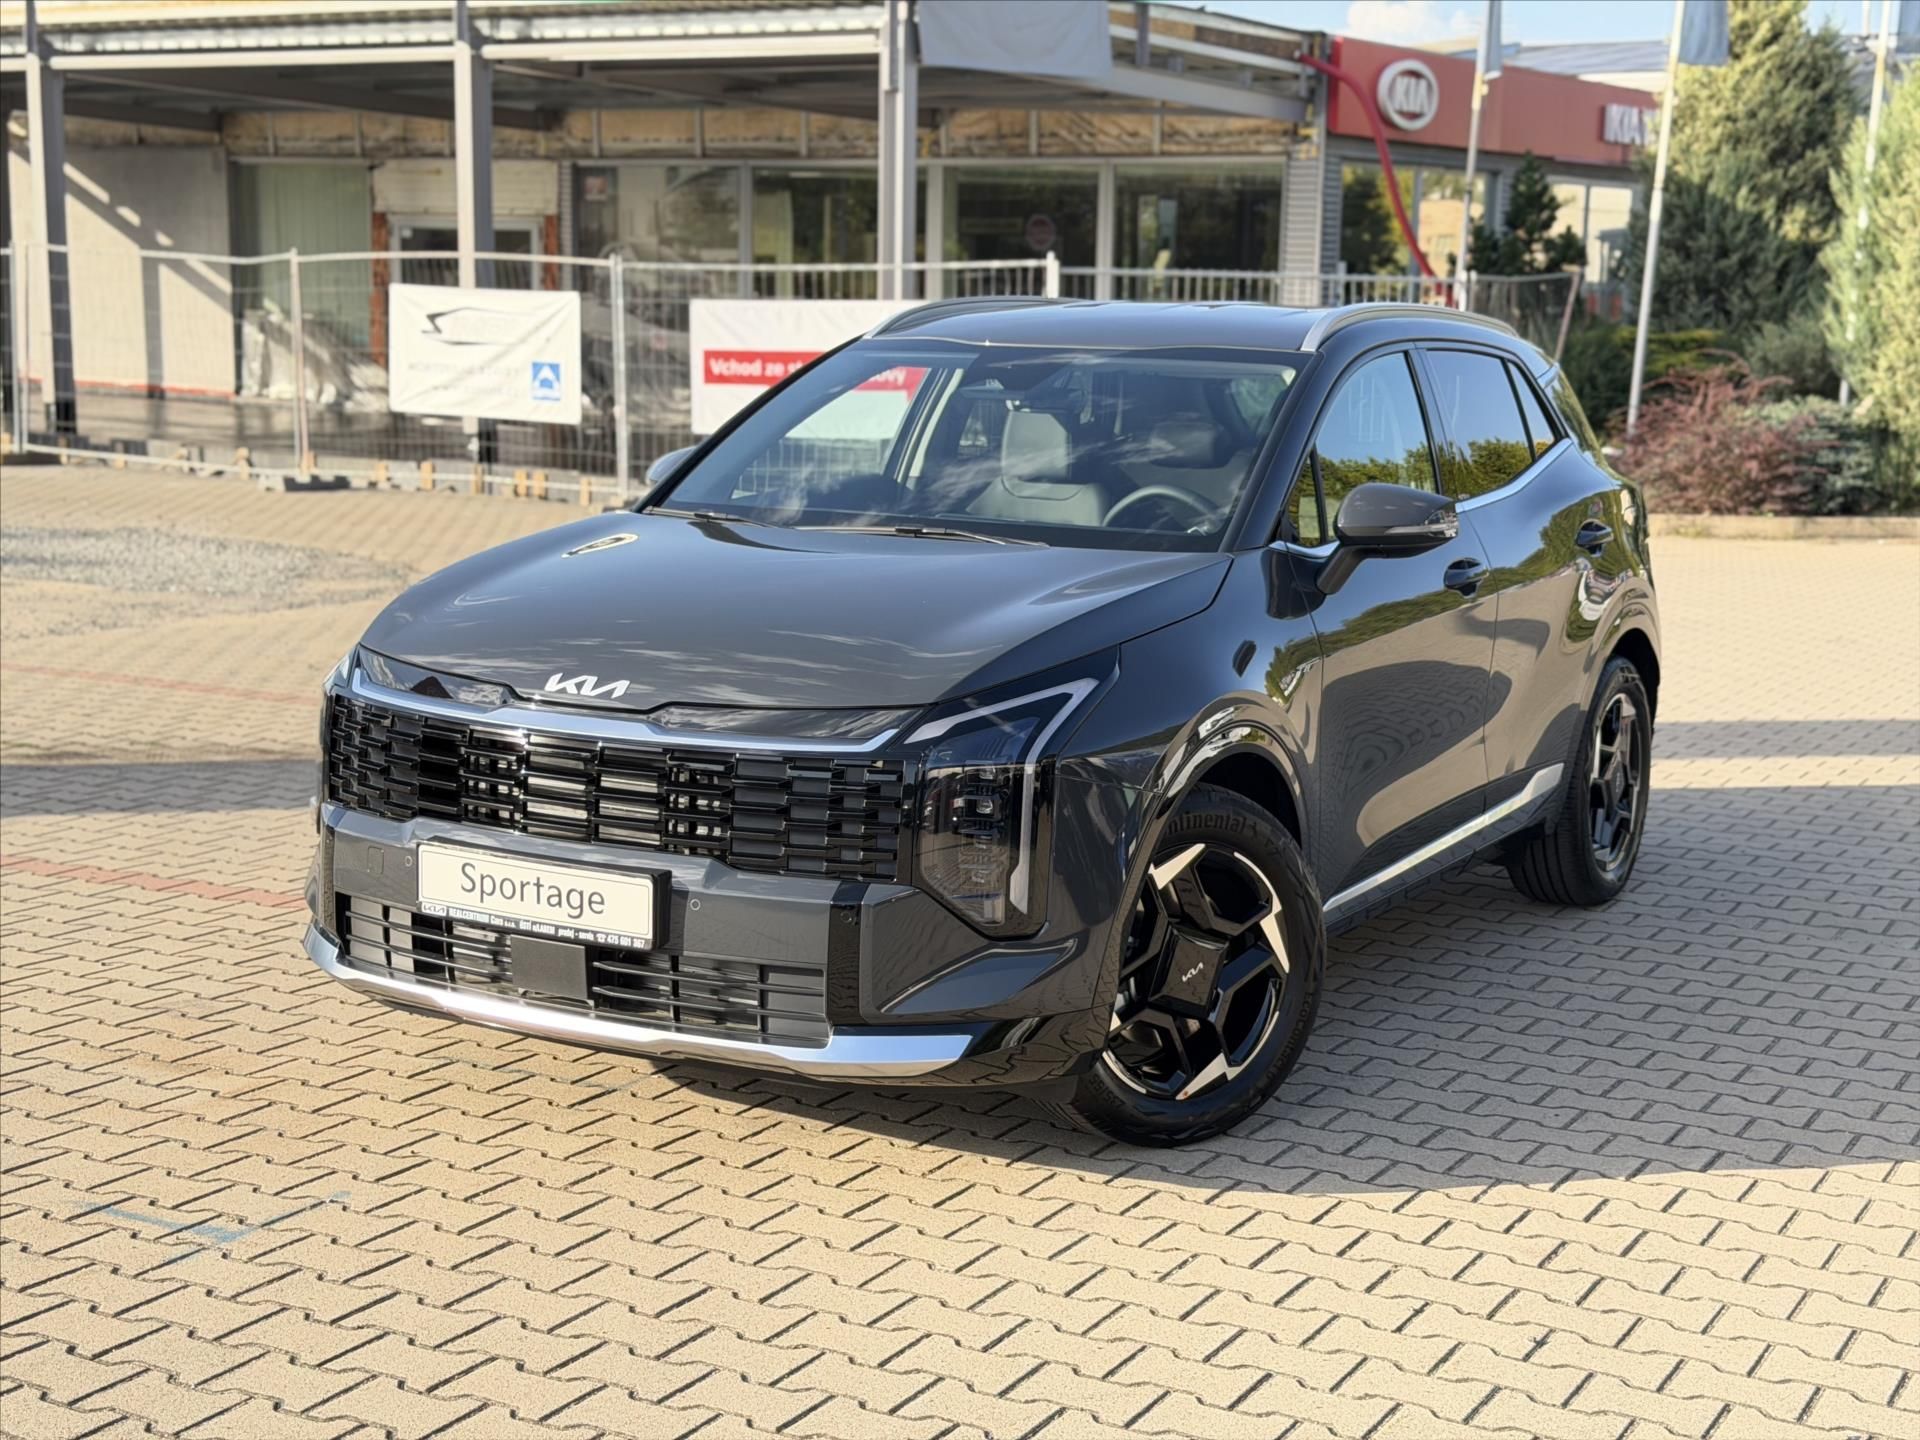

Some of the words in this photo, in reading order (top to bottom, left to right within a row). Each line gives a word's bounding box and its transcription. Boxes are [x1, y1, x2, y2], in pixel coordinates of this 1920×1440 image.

[1393, 76, 1429, 113] KIA
[1605, 104, 1642, 145] KIA
[710, 358, 762, 377] Vchod
[764, 362, 785, 377] ze
[544, 672, 630, 699] KIA
[1167, 810, 1247, 836] ntinental
[460, 861, 606, 919] Sportage
